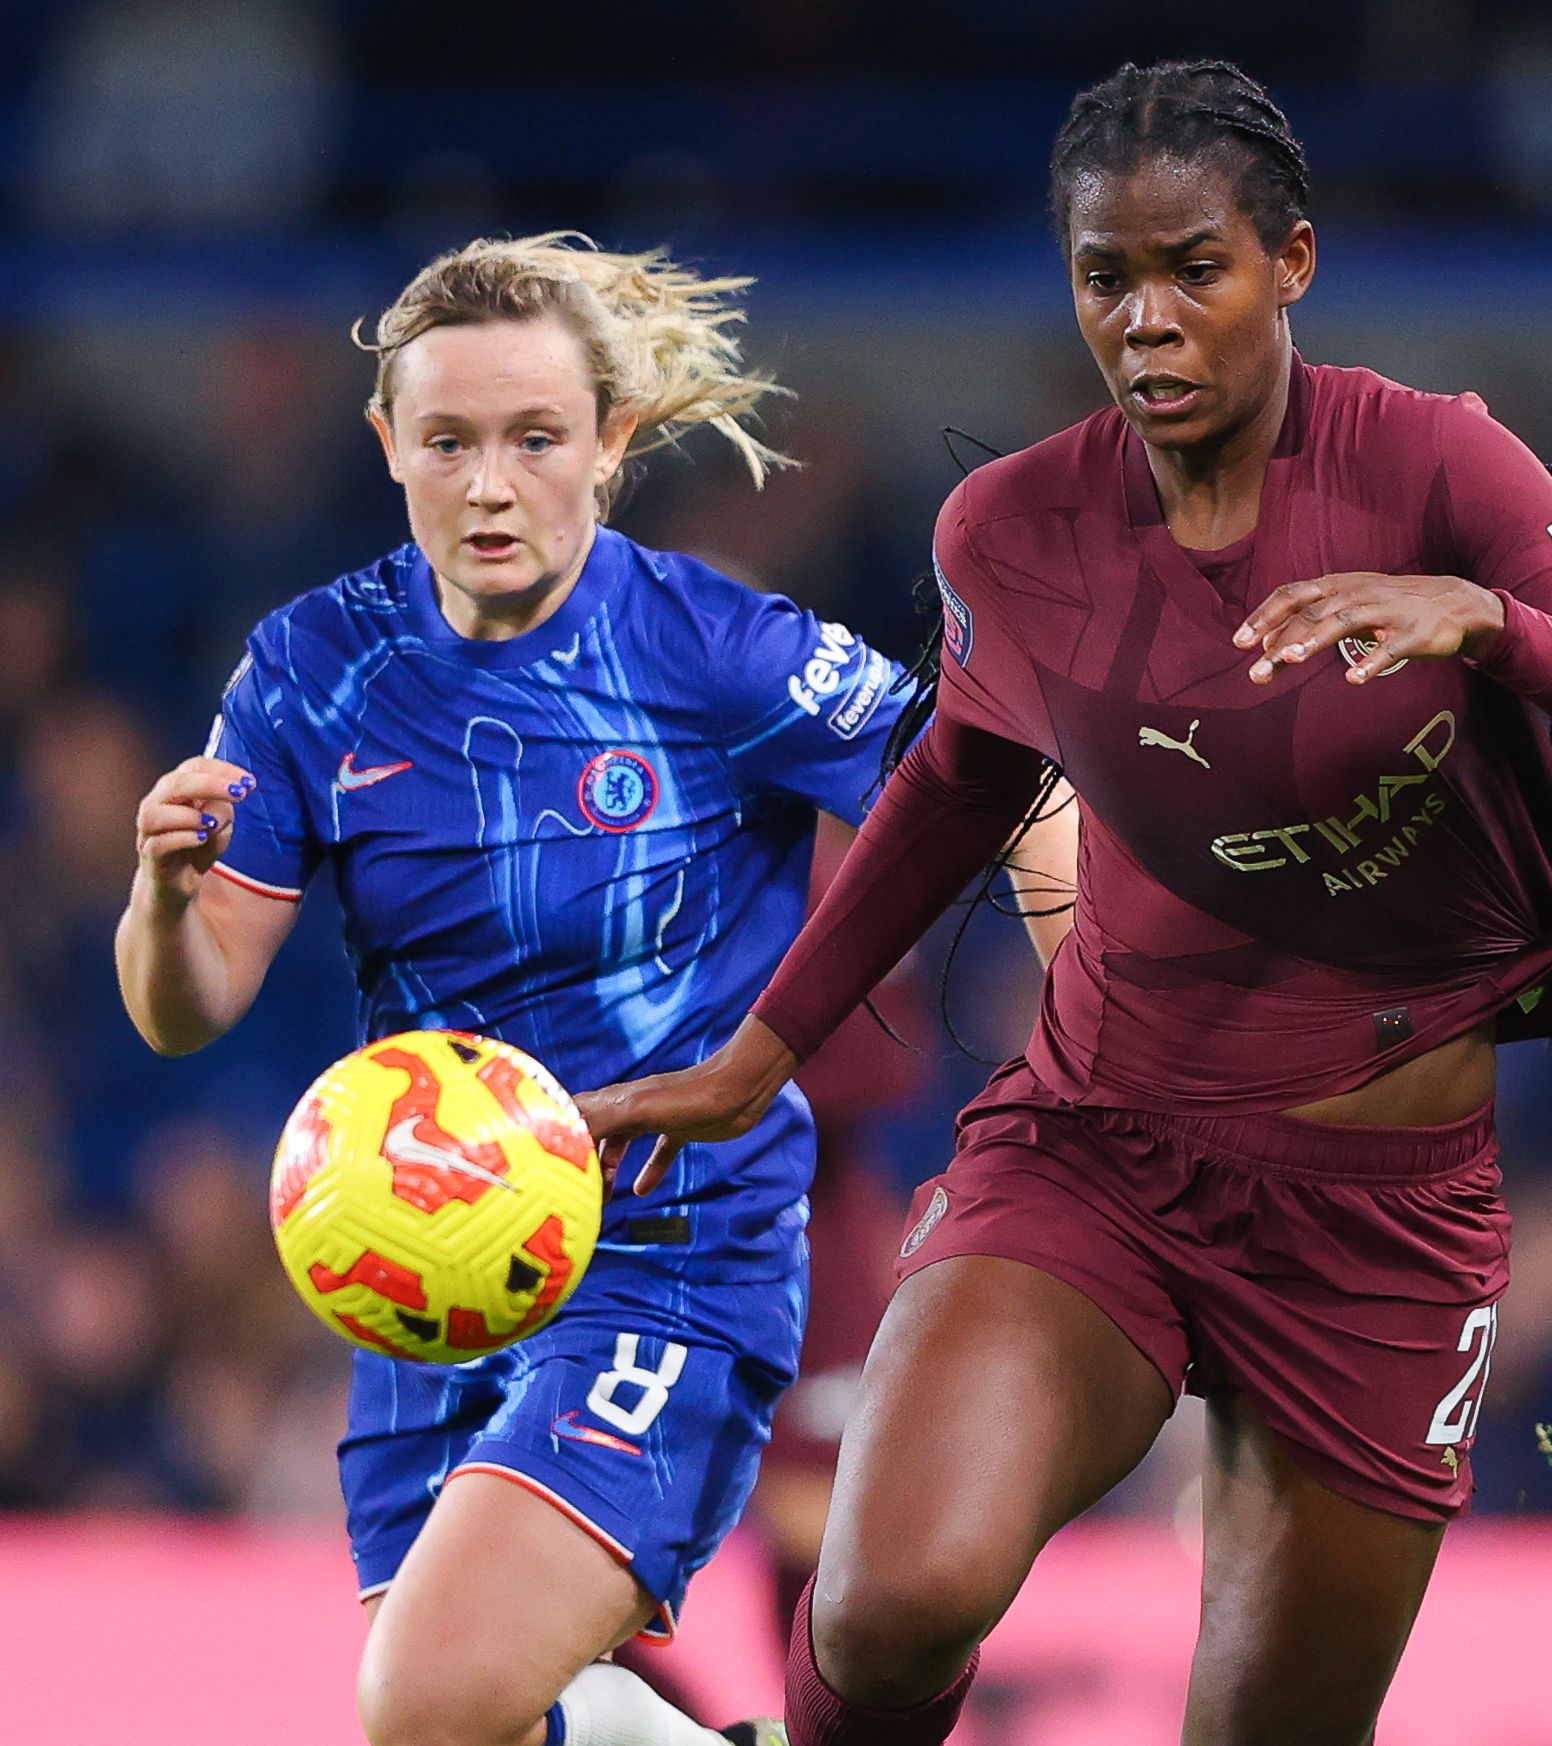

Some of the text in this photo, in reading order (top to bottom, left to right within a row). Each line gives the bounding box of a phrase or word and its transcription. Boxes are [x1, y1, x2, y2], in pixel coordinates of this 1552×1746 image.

[1211, 710, 1455, 871] ETIHAD
[1322, 793, 1445, 896] AIRWAYS
[585, 1332, 688, 1436] 8
